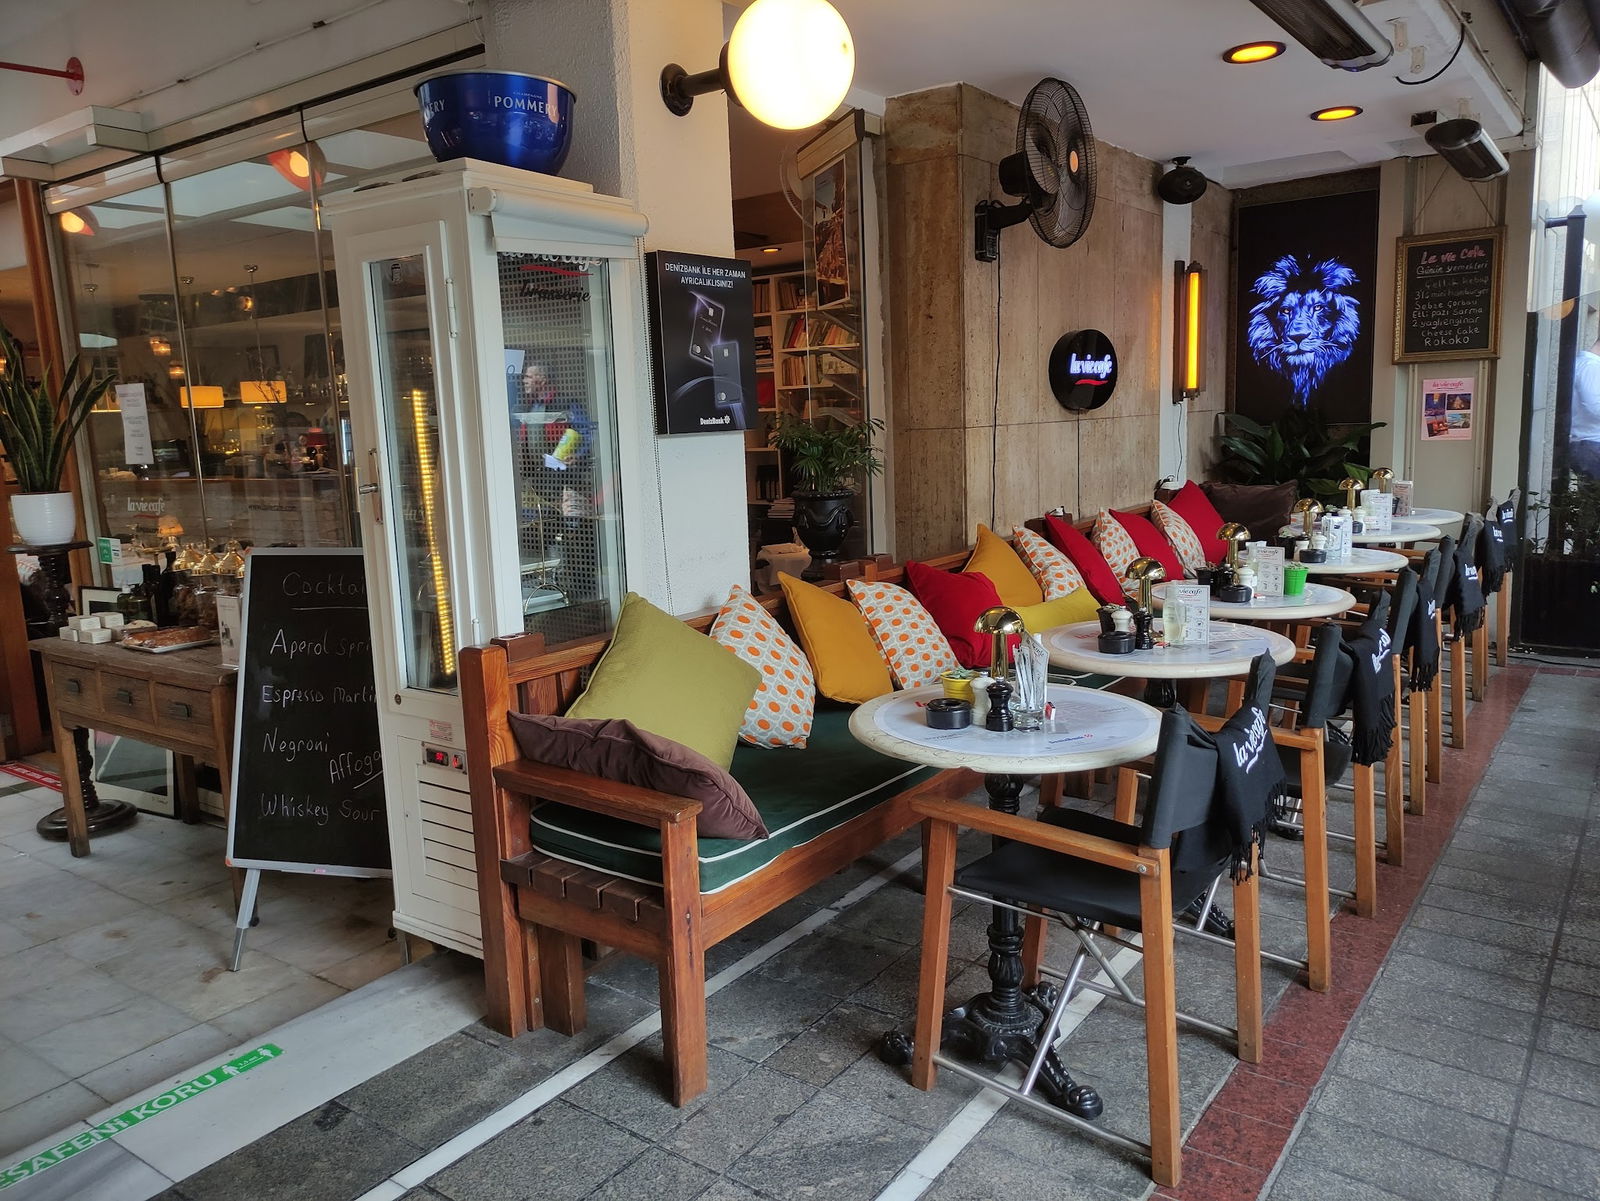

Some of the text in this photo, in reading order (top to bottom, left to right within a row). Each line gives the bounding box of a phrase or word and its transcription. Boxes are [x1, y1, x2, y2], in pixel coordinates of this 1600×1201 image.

[494, 95, 558, 116] POMMERY
[665, 262, 701, 274] DENİZBANK
[712, 268, 724, 277] HER
[725, 269, 746, 279] ZAMAN
[127, 497, 135, 512] la
[270, 628, 329, 660] Aperol
[262, 685, 324, 708] Espresso
[262, 727, 330, 762] Negroni
[261, 793, 381, 826] Whiskey Sour
[130, 1074, 217, 1120] KORU
